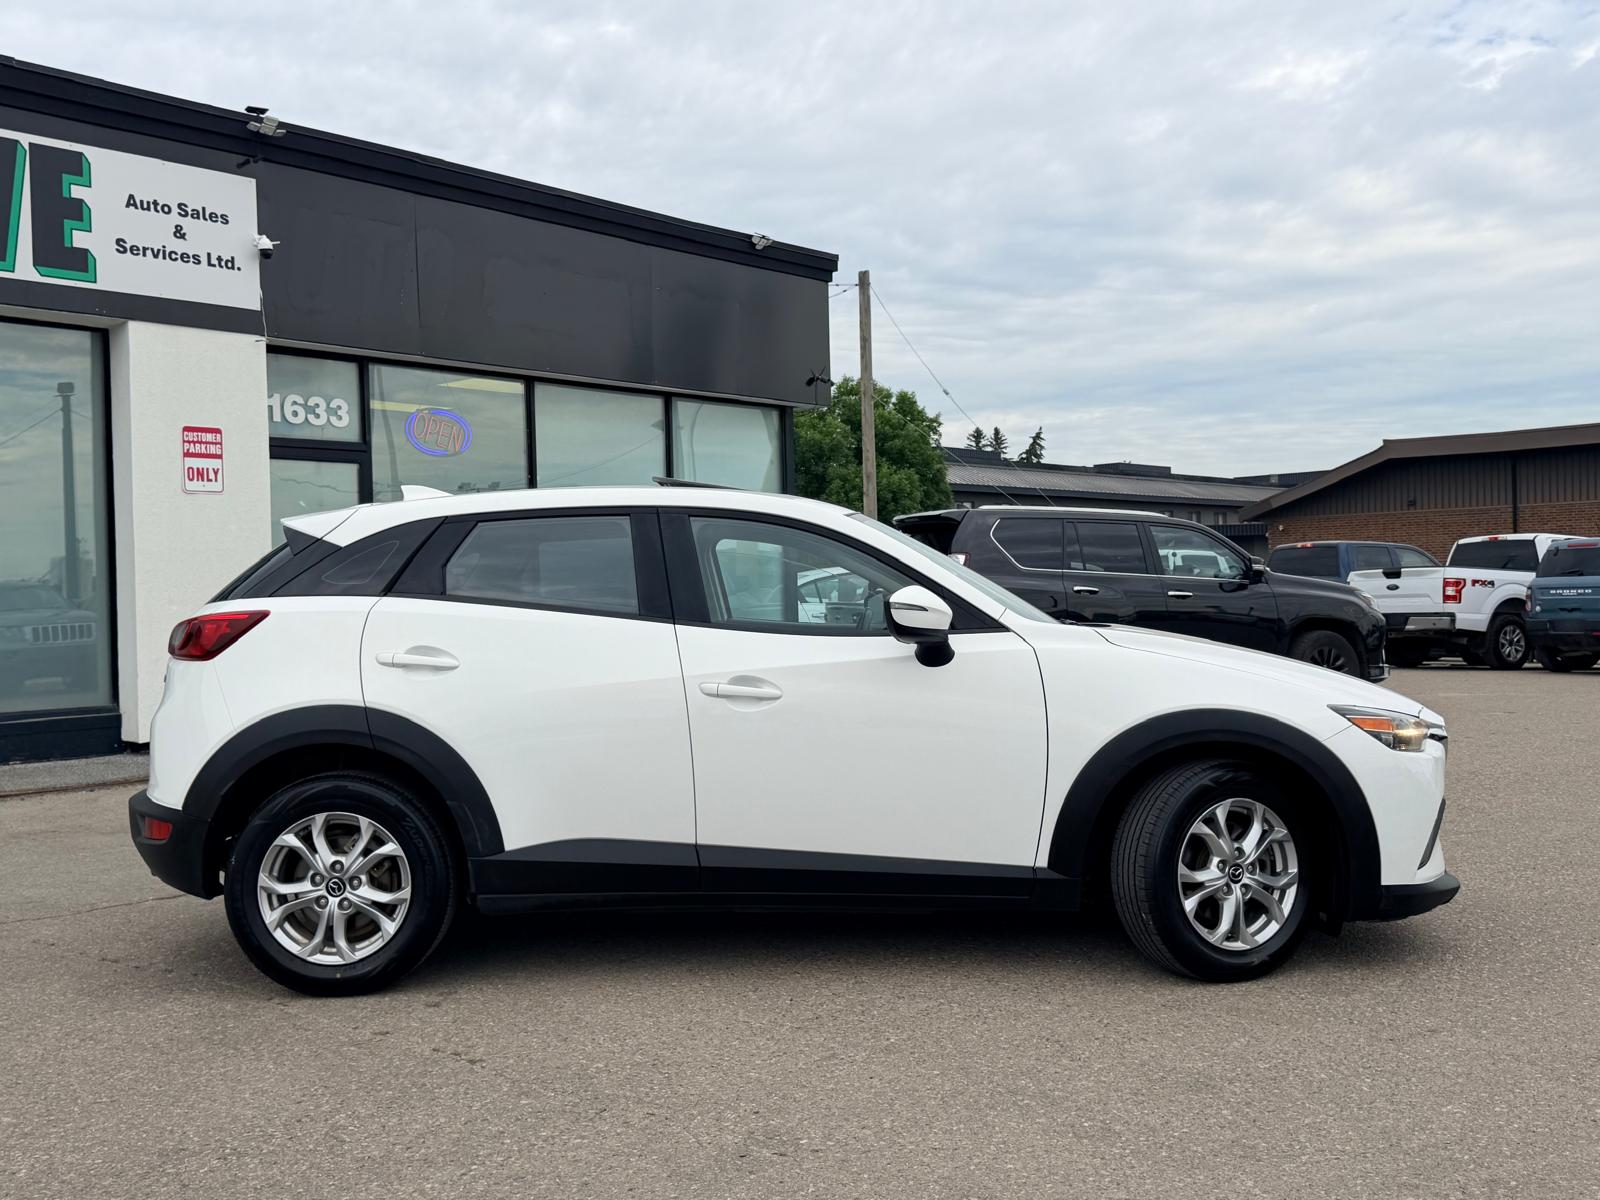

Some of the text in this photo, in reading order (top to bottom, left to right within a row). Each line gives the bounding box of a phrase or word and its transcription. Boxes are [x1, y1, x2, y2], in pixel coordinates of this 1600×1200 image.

[125, 193, 230, 225] Auto Sales
[172, 224, 188, 241] &
[115, 237, 242, 272] Services Ltd.
[267, 393, 350, 428] 1633
[183, 431, 222, 443] CUSTOMER
[412, 411, 463, 454] OPEN
[183, 442, 222, 455] PARKING
[186, 466, 220, 483] ONLY
